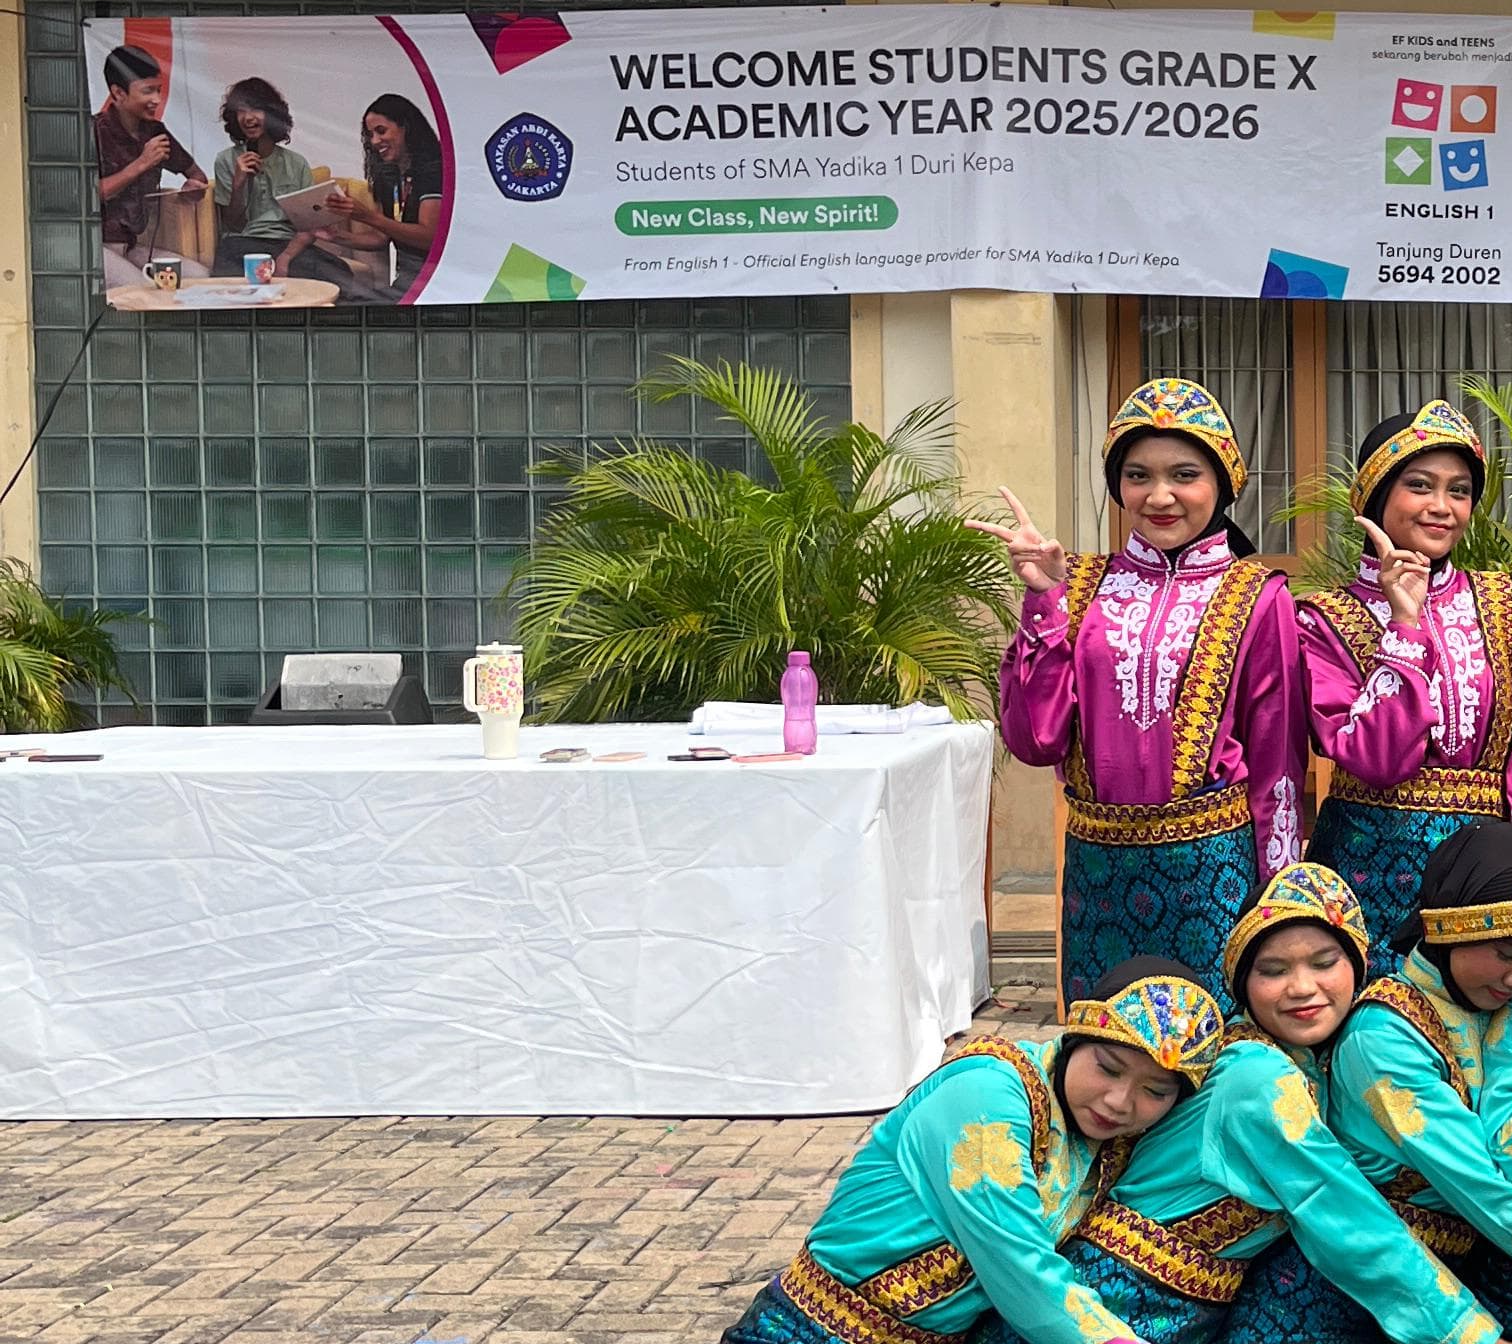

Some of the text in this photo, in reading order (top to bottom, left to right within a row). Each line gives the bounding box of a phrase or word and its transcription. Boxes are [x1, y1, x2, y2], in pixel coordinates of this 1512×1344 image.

[1392, 35, 1495, 48] EF KIDS and TEENS
[1372, 49, 1421, 63] sekarang
[1423, 50, 1469, 62] berubah
[609, 46, 1318, 91] WELCOME STUDENTS GRADE X
[614, 97, 1261, 142] ACADEMIC YEAR 2025/2026
[495, 124, 567, 172] YAYASAN ABDI KARYA
[615, 151, 1015, 183] Students of SMA Yadika 1 Duri Kepa
[507, 180, 559, 196] JAKARTA
[631, 203, 880, 229] New Class, New Spirit!
[1385, 203, 1493, 219] ENGLISH 1
[624, 246, 1180, 273] From English 1 Official English language provider for SMA Yadika 1 Duri Kepa
[1376, 241, 1501, 262] Tanjung Duren
[1378, 264, 1501, 285] 5694 2002
